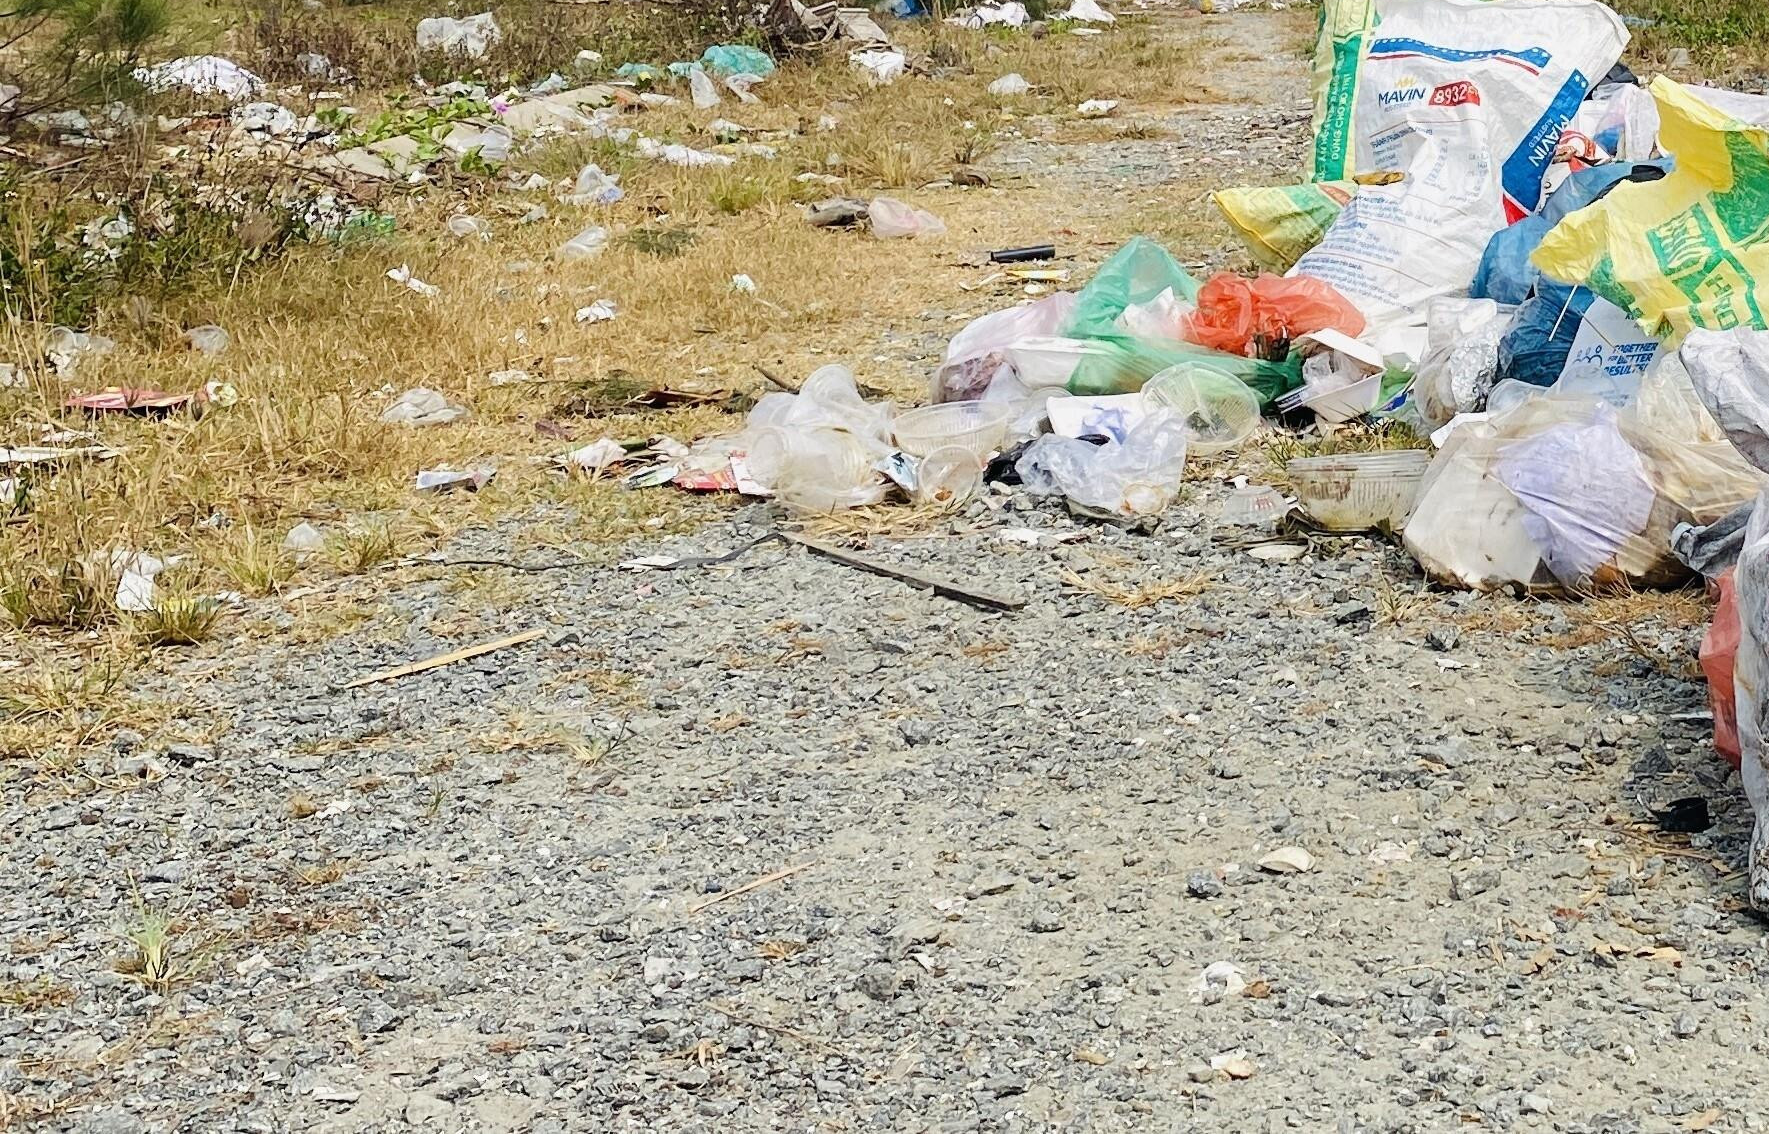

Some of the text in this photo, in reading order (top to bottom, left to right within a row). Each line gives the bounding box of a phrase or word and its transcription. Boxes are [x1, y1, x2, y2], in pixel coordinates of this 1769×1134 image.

[1379, 87, 1426, 107] MAVIN
[1434, 84, 1468, 105] 8932
[1528, 114, 1571, 167] MAVIN
